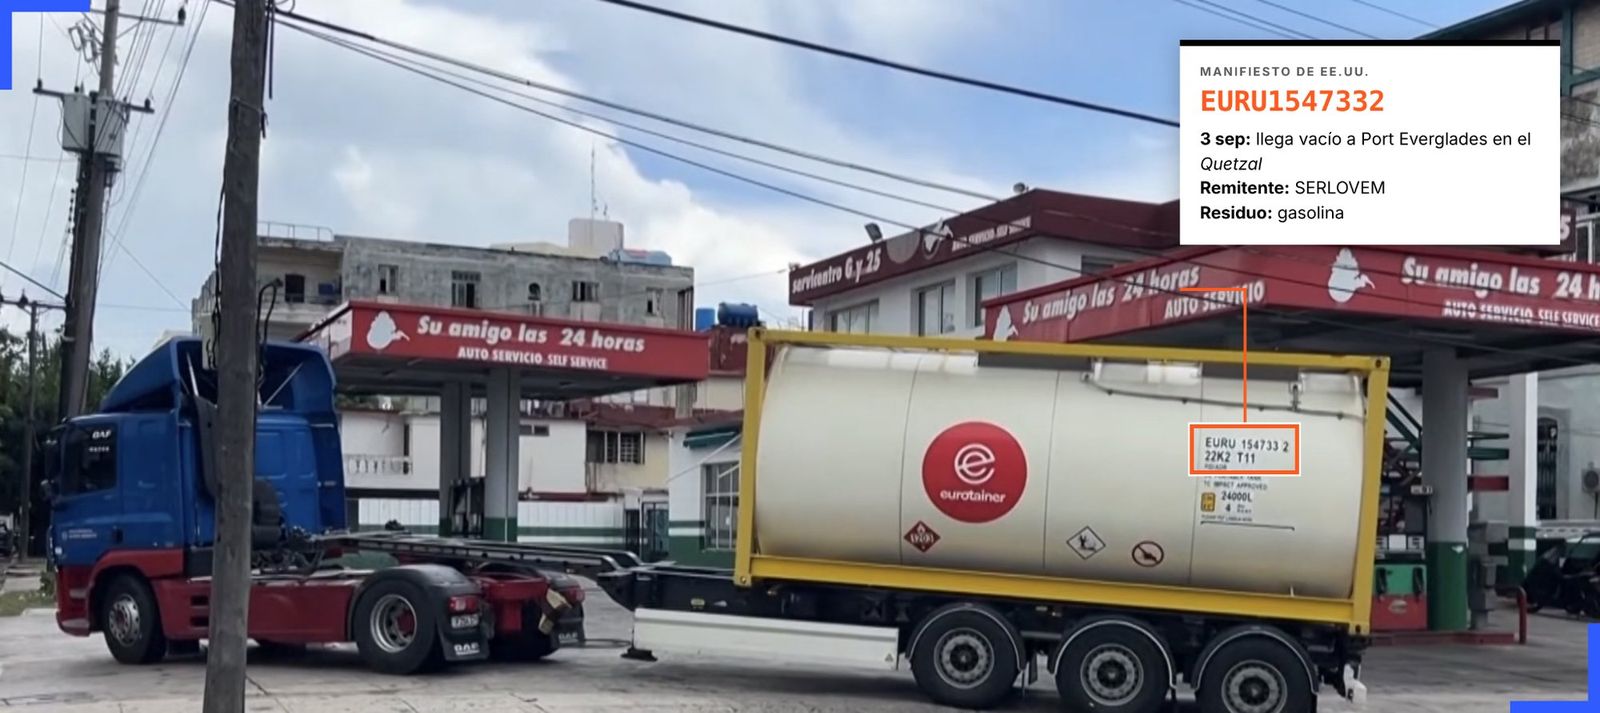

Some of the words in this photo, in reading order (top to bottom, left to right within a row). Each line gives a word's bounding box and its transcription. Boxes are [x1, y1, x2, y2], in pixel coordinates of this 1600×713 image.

[792, 265, 843, 294] servicentro
[1402, 256, 1429, 285] Su
[1435, 262, 1503, 298] amigo
[1508, 266, 1541, 295] las
[1552, 271, 1583, 298] 24
[1022, 300, 1040, 325] Su
[1042, 290, 1088, 320] amigo
[1091, 282, 1116, 309] las
[1148, 266, 1201, 295] horas
[1164, 296, 1199, 319] AUTO
[1442, 300, 1477, 318] AUTO
[1479, 303, 1534, 324] SERVICIO
[417, 314, 443, 335] Su
[448, 319, 512, 346] amigo
[518, 323, 548, 343] las
[560, 327, 586, 347] 24
[591, 329, 645, 352] horas
[458, 345, 489, 360] AUTO
[491, 347, 543, 365] SERVICIO
[547, 353, 568, 366] SELF
[570, 356, 608, 370] SERVICE
[1205, 436, 1236, 449] EURU
[1241, 439, 1279, 451] 154733
[1204, 450, 1231, 463] 22K2
[1237, 452, 1256, 464] T11
[939, 489, 1006, 503] eurotainer
